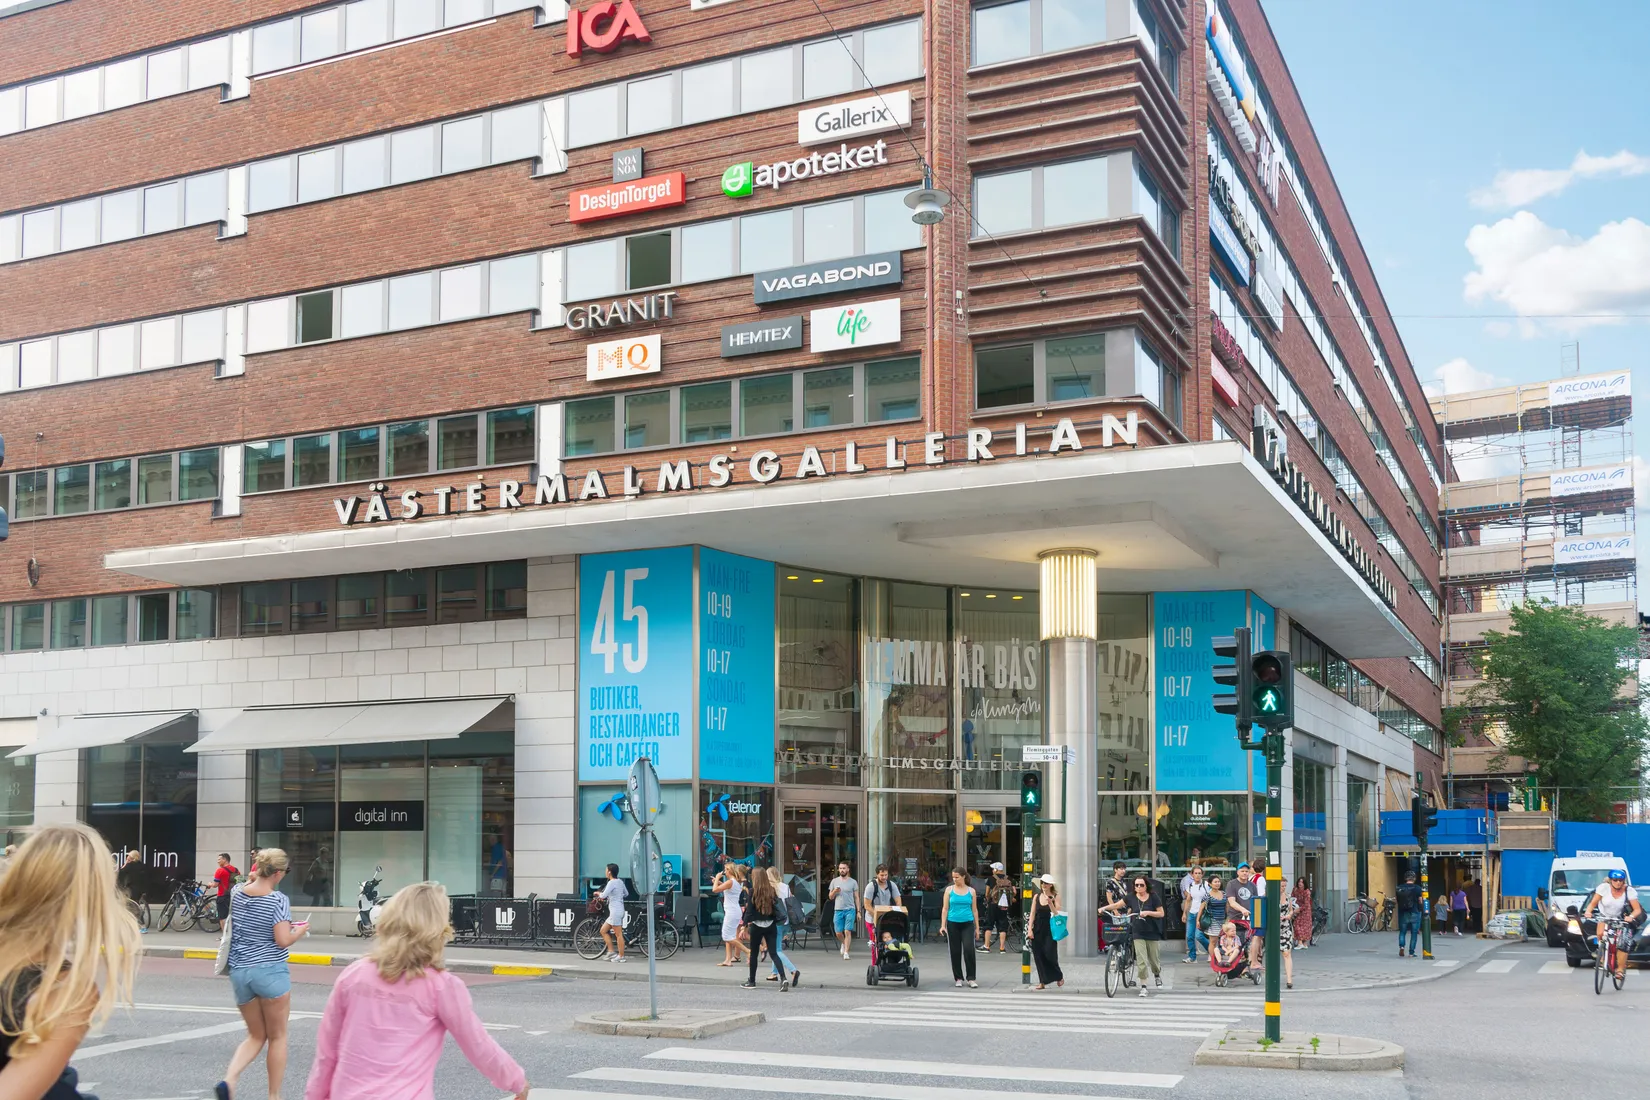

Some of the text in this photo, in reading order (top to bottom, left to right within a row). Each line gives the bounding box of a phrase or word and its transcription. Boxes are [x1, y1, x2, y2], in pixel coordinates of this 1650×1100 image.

[567, 0, 652, 58] ICA
[814, 106, 888, 133] Gallerix
[617, 154, 637, 166] NOA
[617, 165, 637, 176] NOA
[755, 139, 888, 190] apoteket
[580, 178, 672, 212] DesignTorget
[762, 261, 892, 293] VAGABOND
[566, 291, 680, 332] GRANIT
[729, 325, 793, 347] HEMTEX
[837, 309, 872, 345] life
[598, 343, 651, 372] MQ
[1554, 379, 1607, 394] ARCONA
[333, 409, 1139, 526] VÄSTERMALMSGALLERIAN
[1553, 471, 1606, 485] ARCONA
[1560, 540, 1613, 553] ARCONA
[707, 591, 732, 619] 10-19
[590, 567, 649, 674] 45
[1163, 626, 1192, 648] 10-19
[707, 648, 731, 675] 10-17
[958, 635, 985, 689] ÄR
[994, 637, 1041, 691] BÄS
[590, 685, 642, 711] BUTIKER,
[1163, 675, 1192, 697] 10-17
[589, 712, 680, 739] RESTAURANGER
[706, 705, 728, 731] 11-17
[1163, 725, 1189, 747] 11-17
[589, 742, 613, 768] OCH
[779, 747, 1040, 772] VÄSTERMALMSGALLERIA
[355, 807, 408, 825] digital inn
[728, 800, 762, 815] telenor
[111, 844, 178, 872] gitl inn
